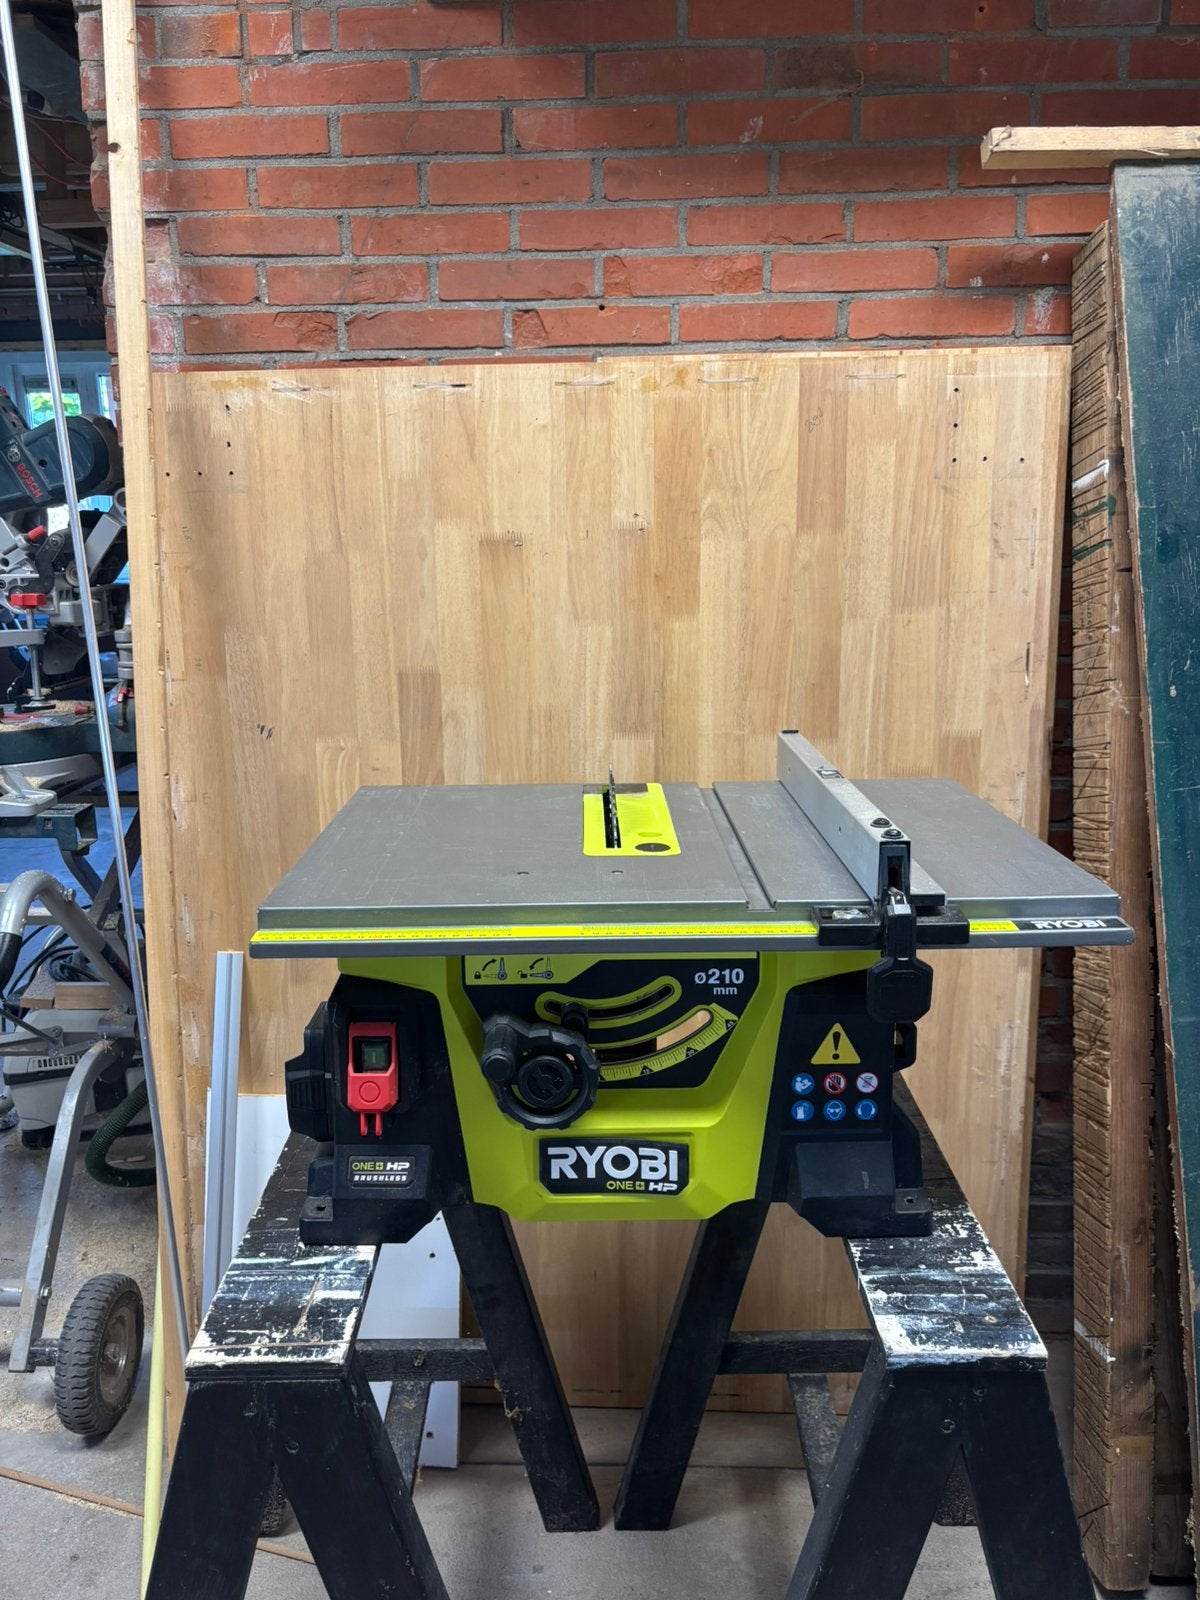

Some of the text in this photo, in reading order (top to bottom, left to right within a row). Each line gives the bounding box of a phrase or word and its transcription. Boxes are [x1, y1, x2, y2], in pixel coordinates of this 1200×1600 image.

[16, 463, 43, 498] BOSCH
[1031, 919, 1107, 929] RYOBI
[713, 987, 738, 995] mm
[386, 1162, 410, 1171] HP
[547, 1145, 679, 1181] RYOBI
[353, 1174, 408, 1182] BRUSHLESS
[648, 1182, 679, 1192] HP
